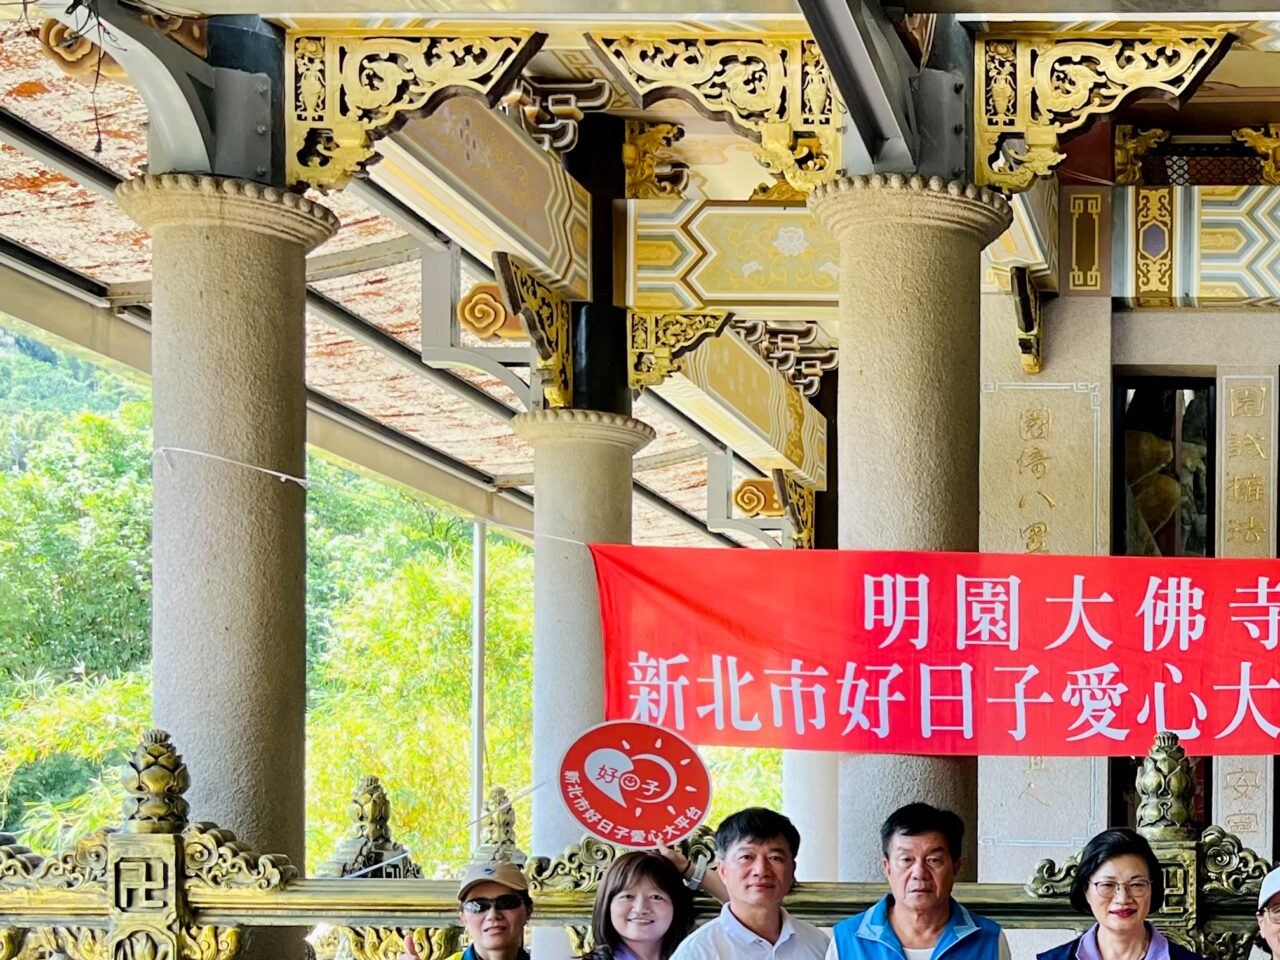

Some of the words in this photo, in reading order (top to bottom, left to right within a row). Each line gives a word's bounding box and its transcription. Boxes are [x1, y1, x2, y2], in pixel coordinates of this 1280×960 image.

[564, 770, 702, 843] 新北市好日子愛心大平台
